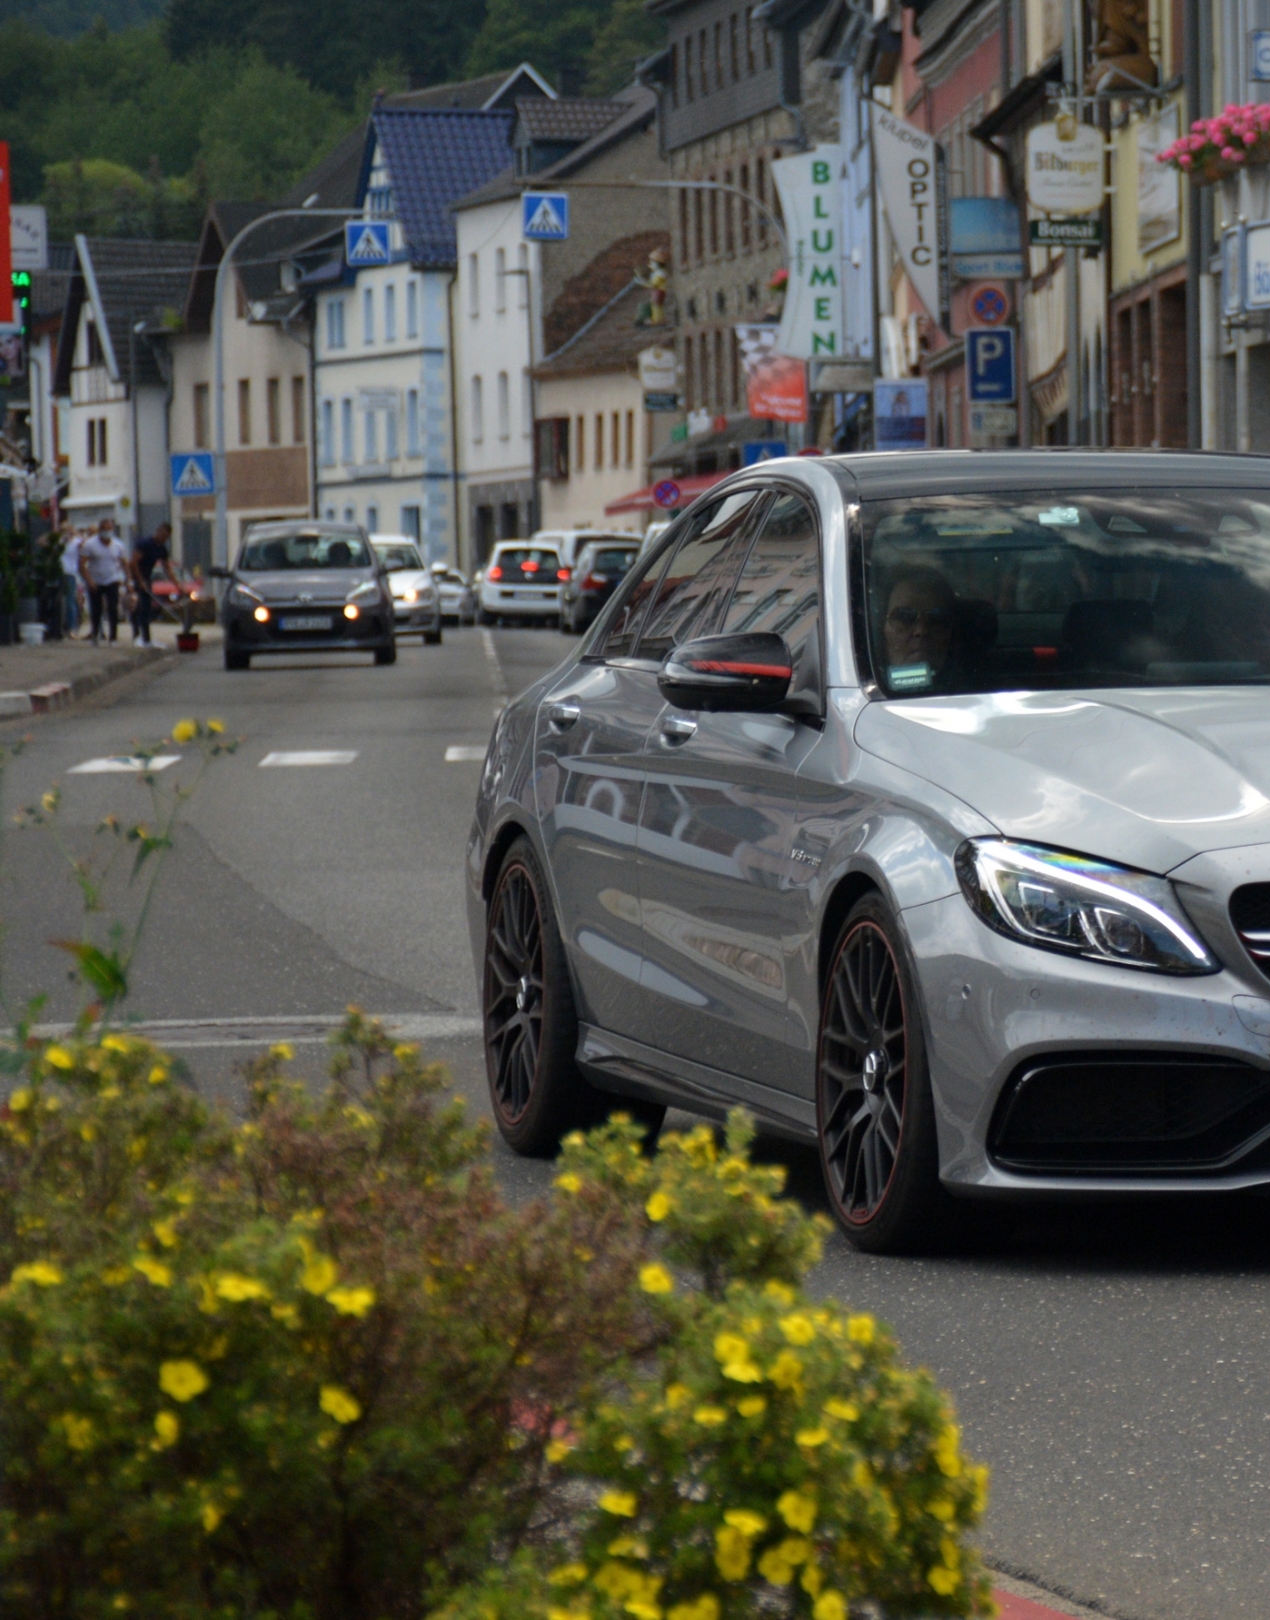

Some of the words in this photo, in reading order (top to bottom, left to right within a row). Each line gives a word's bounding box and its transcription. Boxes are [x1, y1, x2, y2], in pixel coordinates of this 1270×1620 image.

[907, 158, 932, 266] OPTIC
[1038, 220, 1096, 238] Bonsai
[809, 161, 838, 355] BLUMEN
[976, 336, 1003, 377] P
